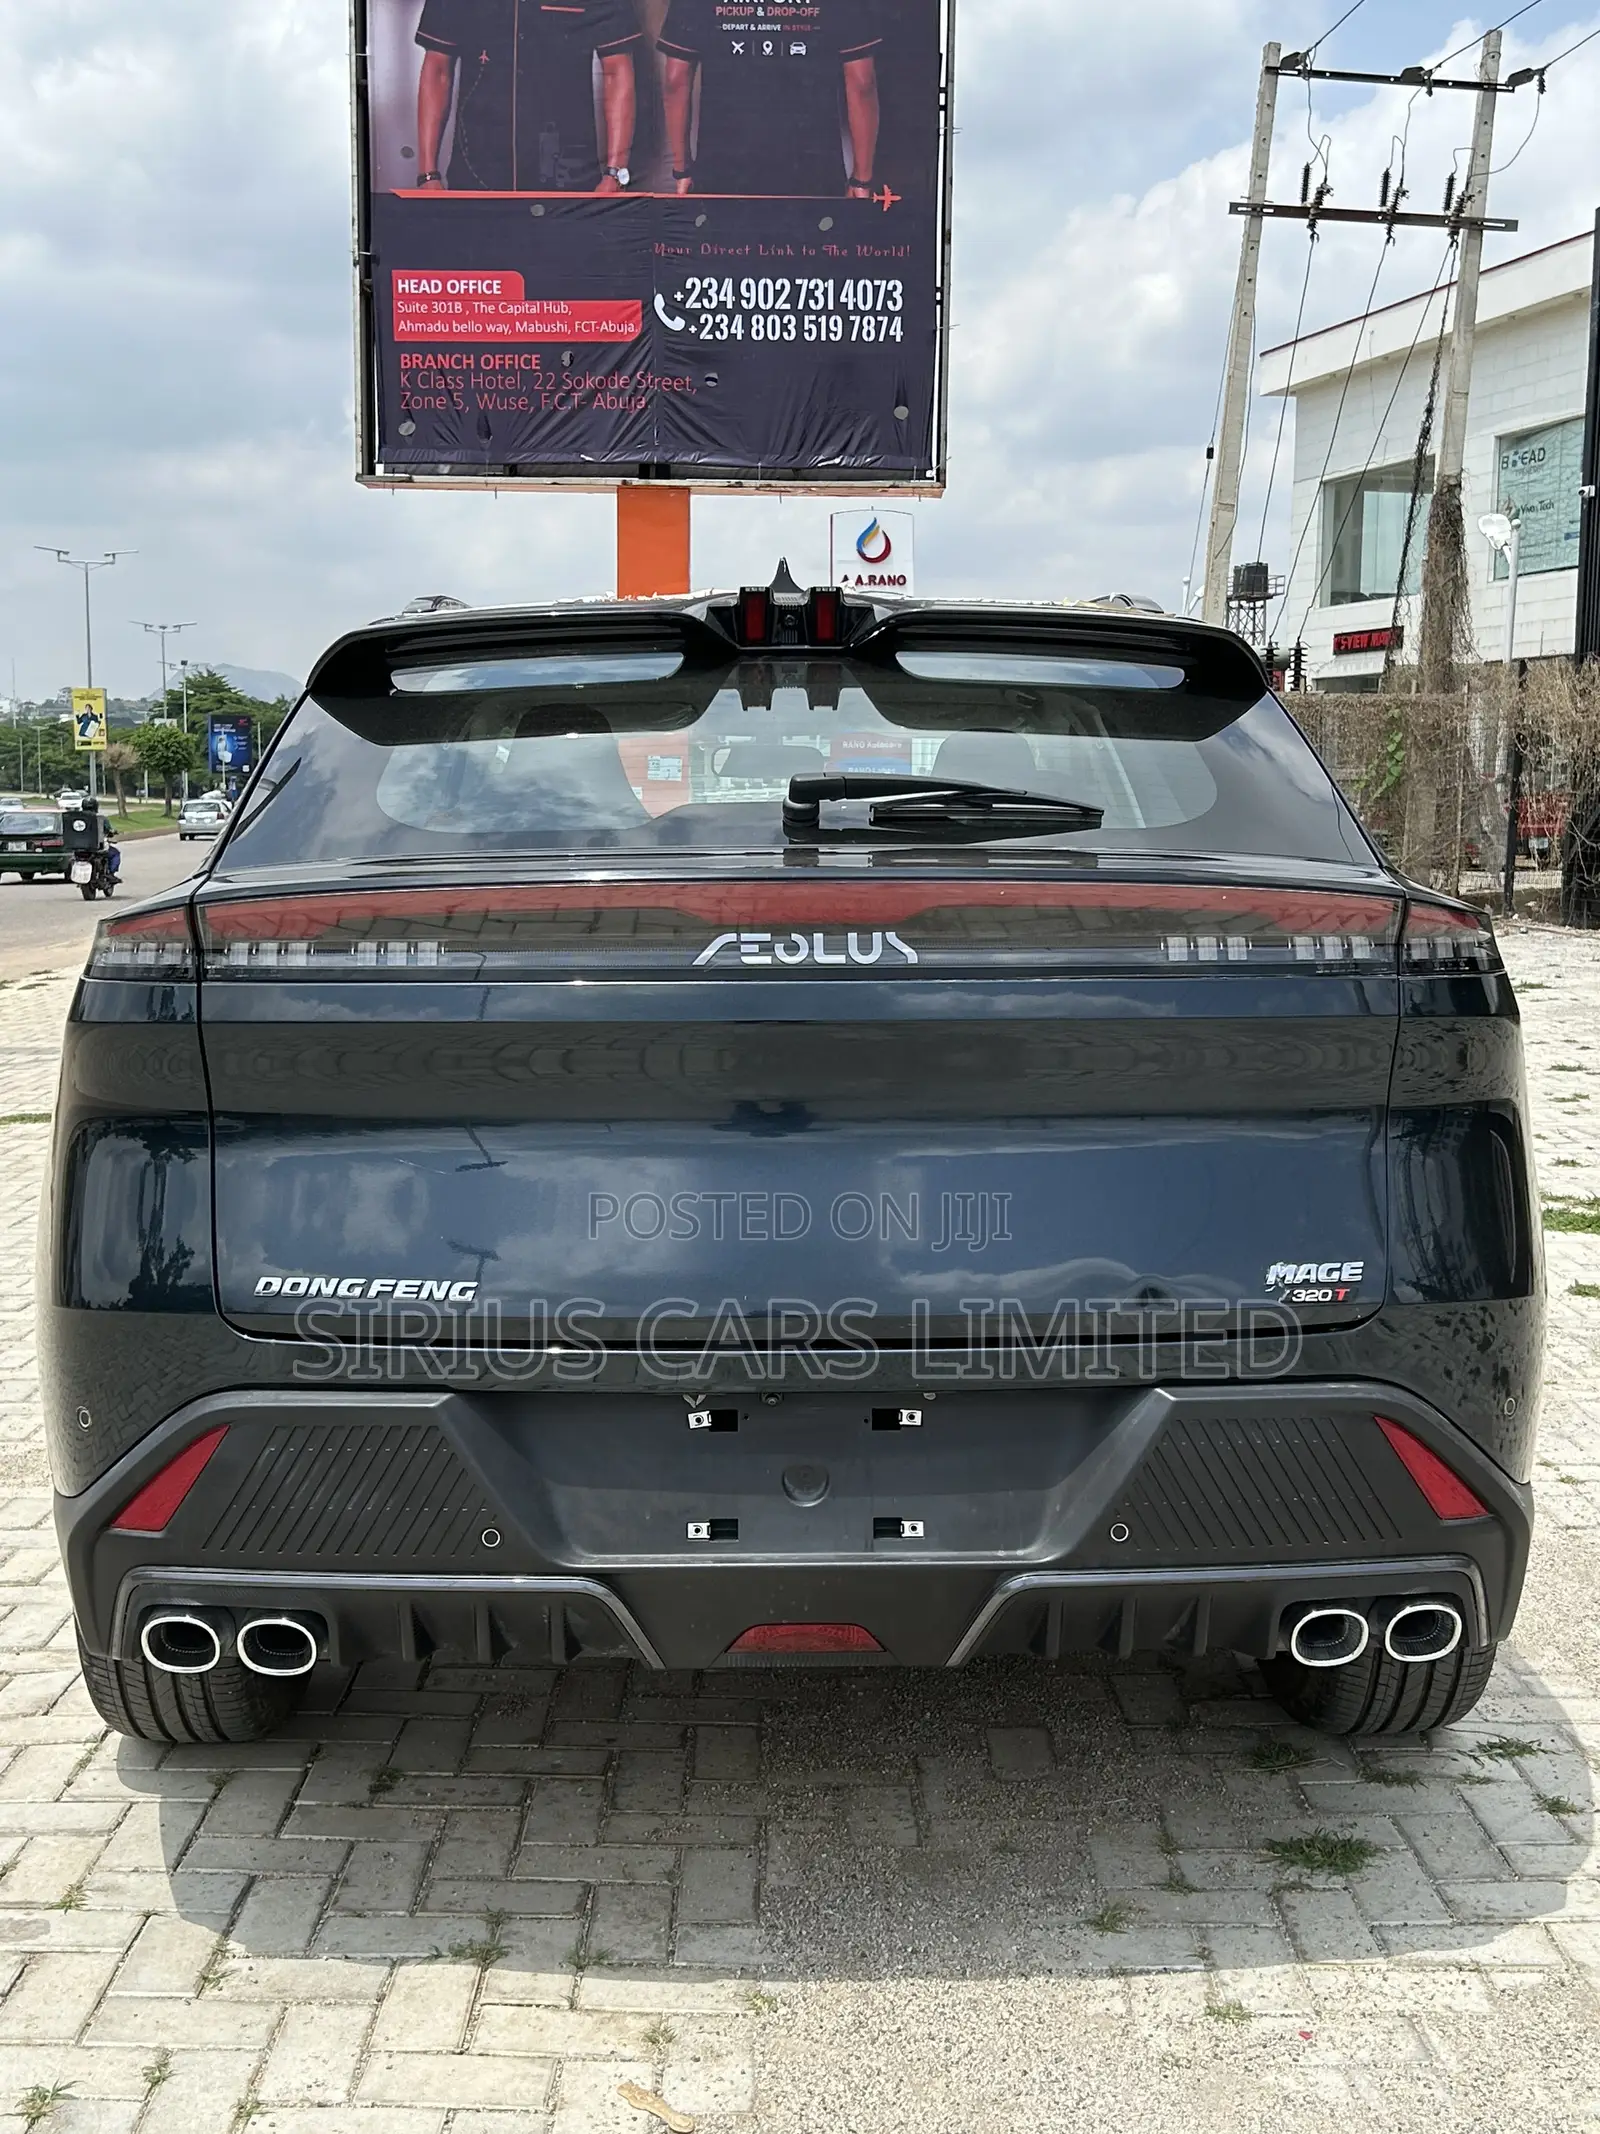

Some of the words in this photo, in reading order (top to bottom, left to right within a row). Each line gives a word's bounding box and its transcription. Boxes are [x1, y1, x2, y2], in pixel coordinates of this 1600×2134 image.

[715, 6, 755, 16] PICKUP
[756, 7, 765, 17] &
[767, 7, 820, 17] DROP-OFF
[653, 242, 693, 256] Your
[700, 242, 751, 256] Direct
[759, 243, 795, 257] Link
[802, 245, 816, 257] to
[822, 244, 849, 257] The
[856, 244, 912, 257] World!
[397, 279, 443, 294] HEAD
[446, 279, 502, 294] OFFICE
[673, 277, 736, 310] +234
[739, 277, 791, 311] 902
[795, 278, 835, 311] 731
[839, 278, 903, 312] 4073
[397, 301, 428, 314] Suite
[472, 302, 496, 314] The
[498, 301, 541, 317] Capital
[543, 302, 573, 316] Hub,
[398, 320, 449, 333] Ahmadu
[452, 320, 483, 333] bello
[485, 323, 512, 336] way,
[515, 321, 572, 335] Mabushi,
[574, 320, 639, 336] FCT-Abuja.
[688, 313, 745, 341] +234
[750, 313, 797, 341] 803
[803, 314, 843, 342] 519
[849, 315, 903, 343] 7874
[400, 354, 475, 369] BRANCH
[480, 354, 541, 370] OFFICE
[400, 372, 411, 389] K
[417, 371, 465, 390] Class
[470, 371, 527, 393] Hotel,
[533, 372, 556, 390] 22
[562, 371, 630, 390] Sokode
[636, 371, 698, 395] Street,
[400, 392, 447, 410] Zone
[452, 391, 471, 413] 5,
[476, 391, 535, 413] Wuse,
[692, 931, 919, 966] AEOLUS
[1265, 1261, 1365, 1285] MAGE
